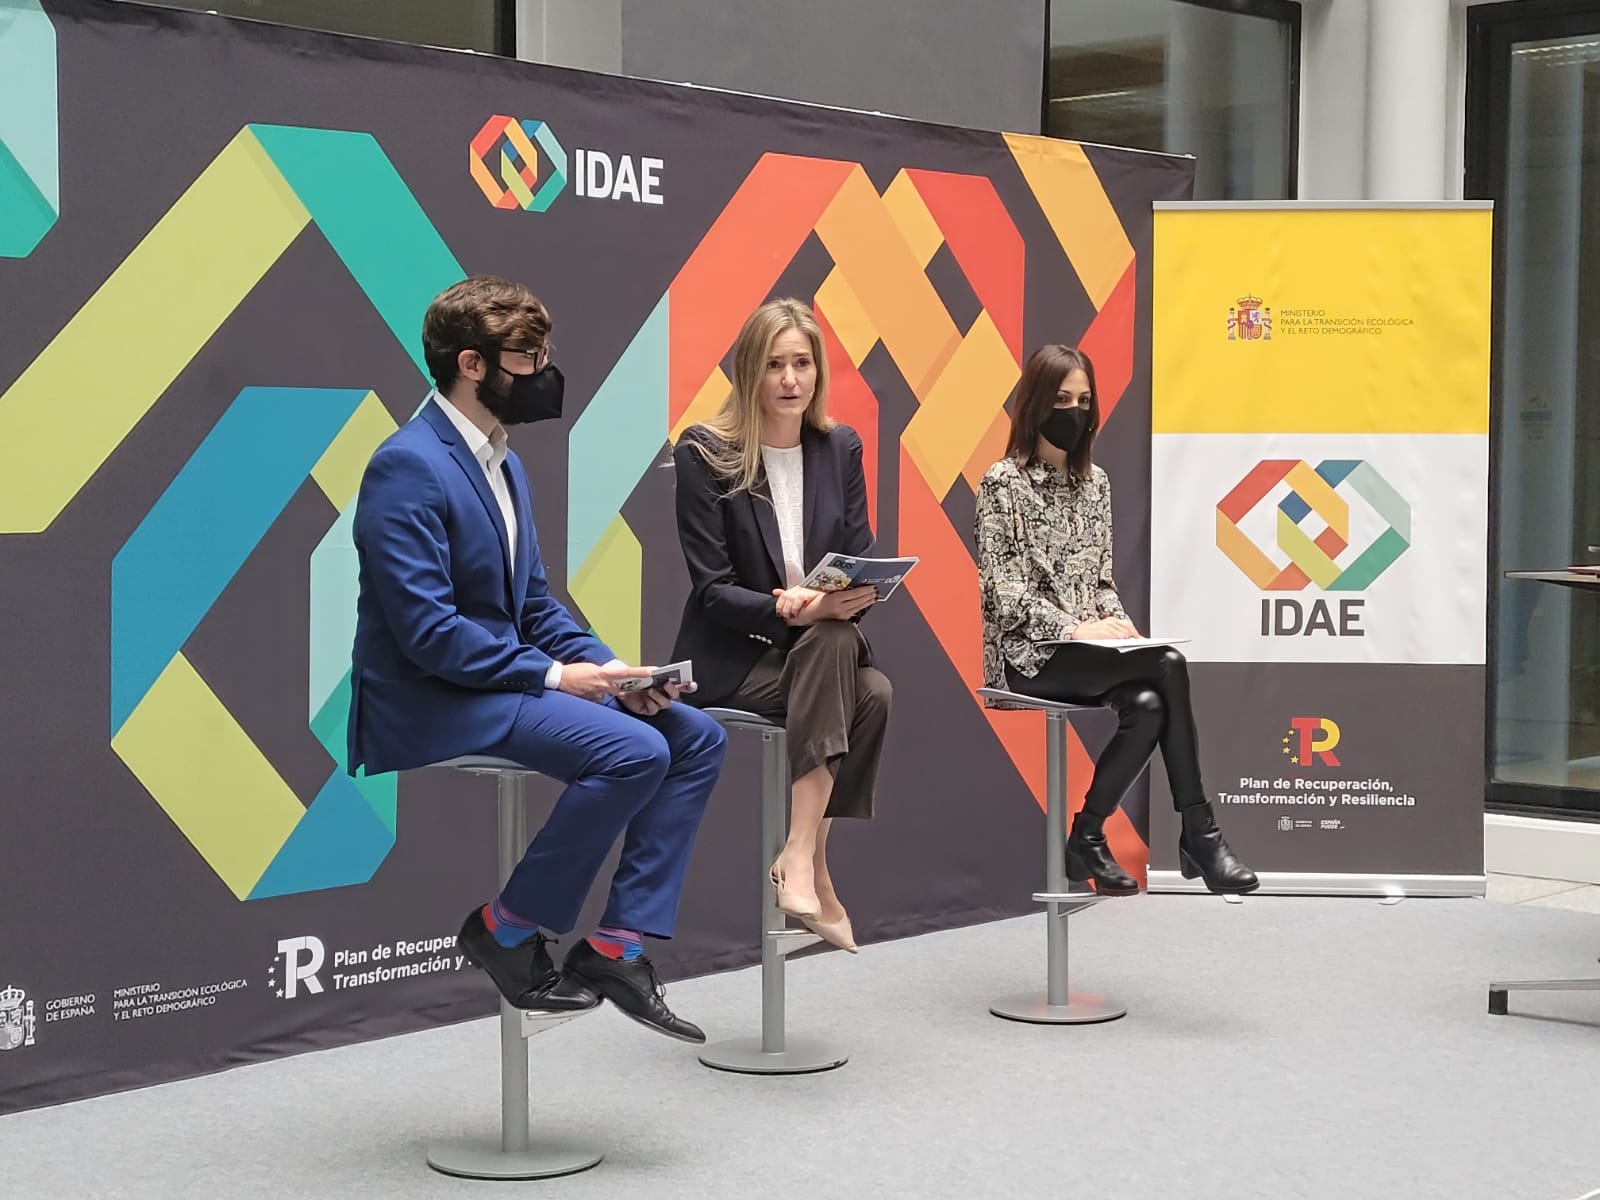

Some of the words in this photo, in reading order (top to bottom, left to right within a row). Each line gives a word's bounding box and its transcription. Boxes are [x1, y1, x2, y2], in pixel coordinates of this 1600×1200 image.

[575, 148, 664, 205] IDAE
[1315, 317, 1363, 326] TRANSICIÓN
[1366, 317, 1414, 327] ECOLÓGICA
[1322, 326, 1382, 335] DEMOGRÁFICO
[1261, 599, 1365, 636] IDAE
[1240, 778, 1269, 789] Plan
[1273, 778, 1291, 789] de
[1295, 778, 1394, 792] Recuperación,
[1218, 793, 1325, 805] Transformación
[1329, 796, 1337, 807] y
[1341, 795, 1416, 806] Resiliencia
[334, 950, 367, 967] Plan
[371, 944, 391, 960] de
[395, 936, 458, 956] Recuper
[333, 957, 451, 990] Transformación
[454, 954, 464, 971] y
[113, 983, 161, 998] MINISTERIO
[113, 1000, 135, 1009] PARA
[136, 997, 148, 1005] LA
[149, 986, 199, 1004] TRANSICIÓN
[200, 979, 248, 995] ECOLÓGICA
[46, 994, 96, 1010] GOBIERNO
[113, 1011, 120, 1021] Y
[121, 1010, 131, 1019] EL
[132, 1006, 155, 1017] RETO
[156, 996, 216, 1014] DEMOGRÁFICO
[45, 1012, 59, 1022] DE
[60, 1005, 96, 1020] ESPAÑA
